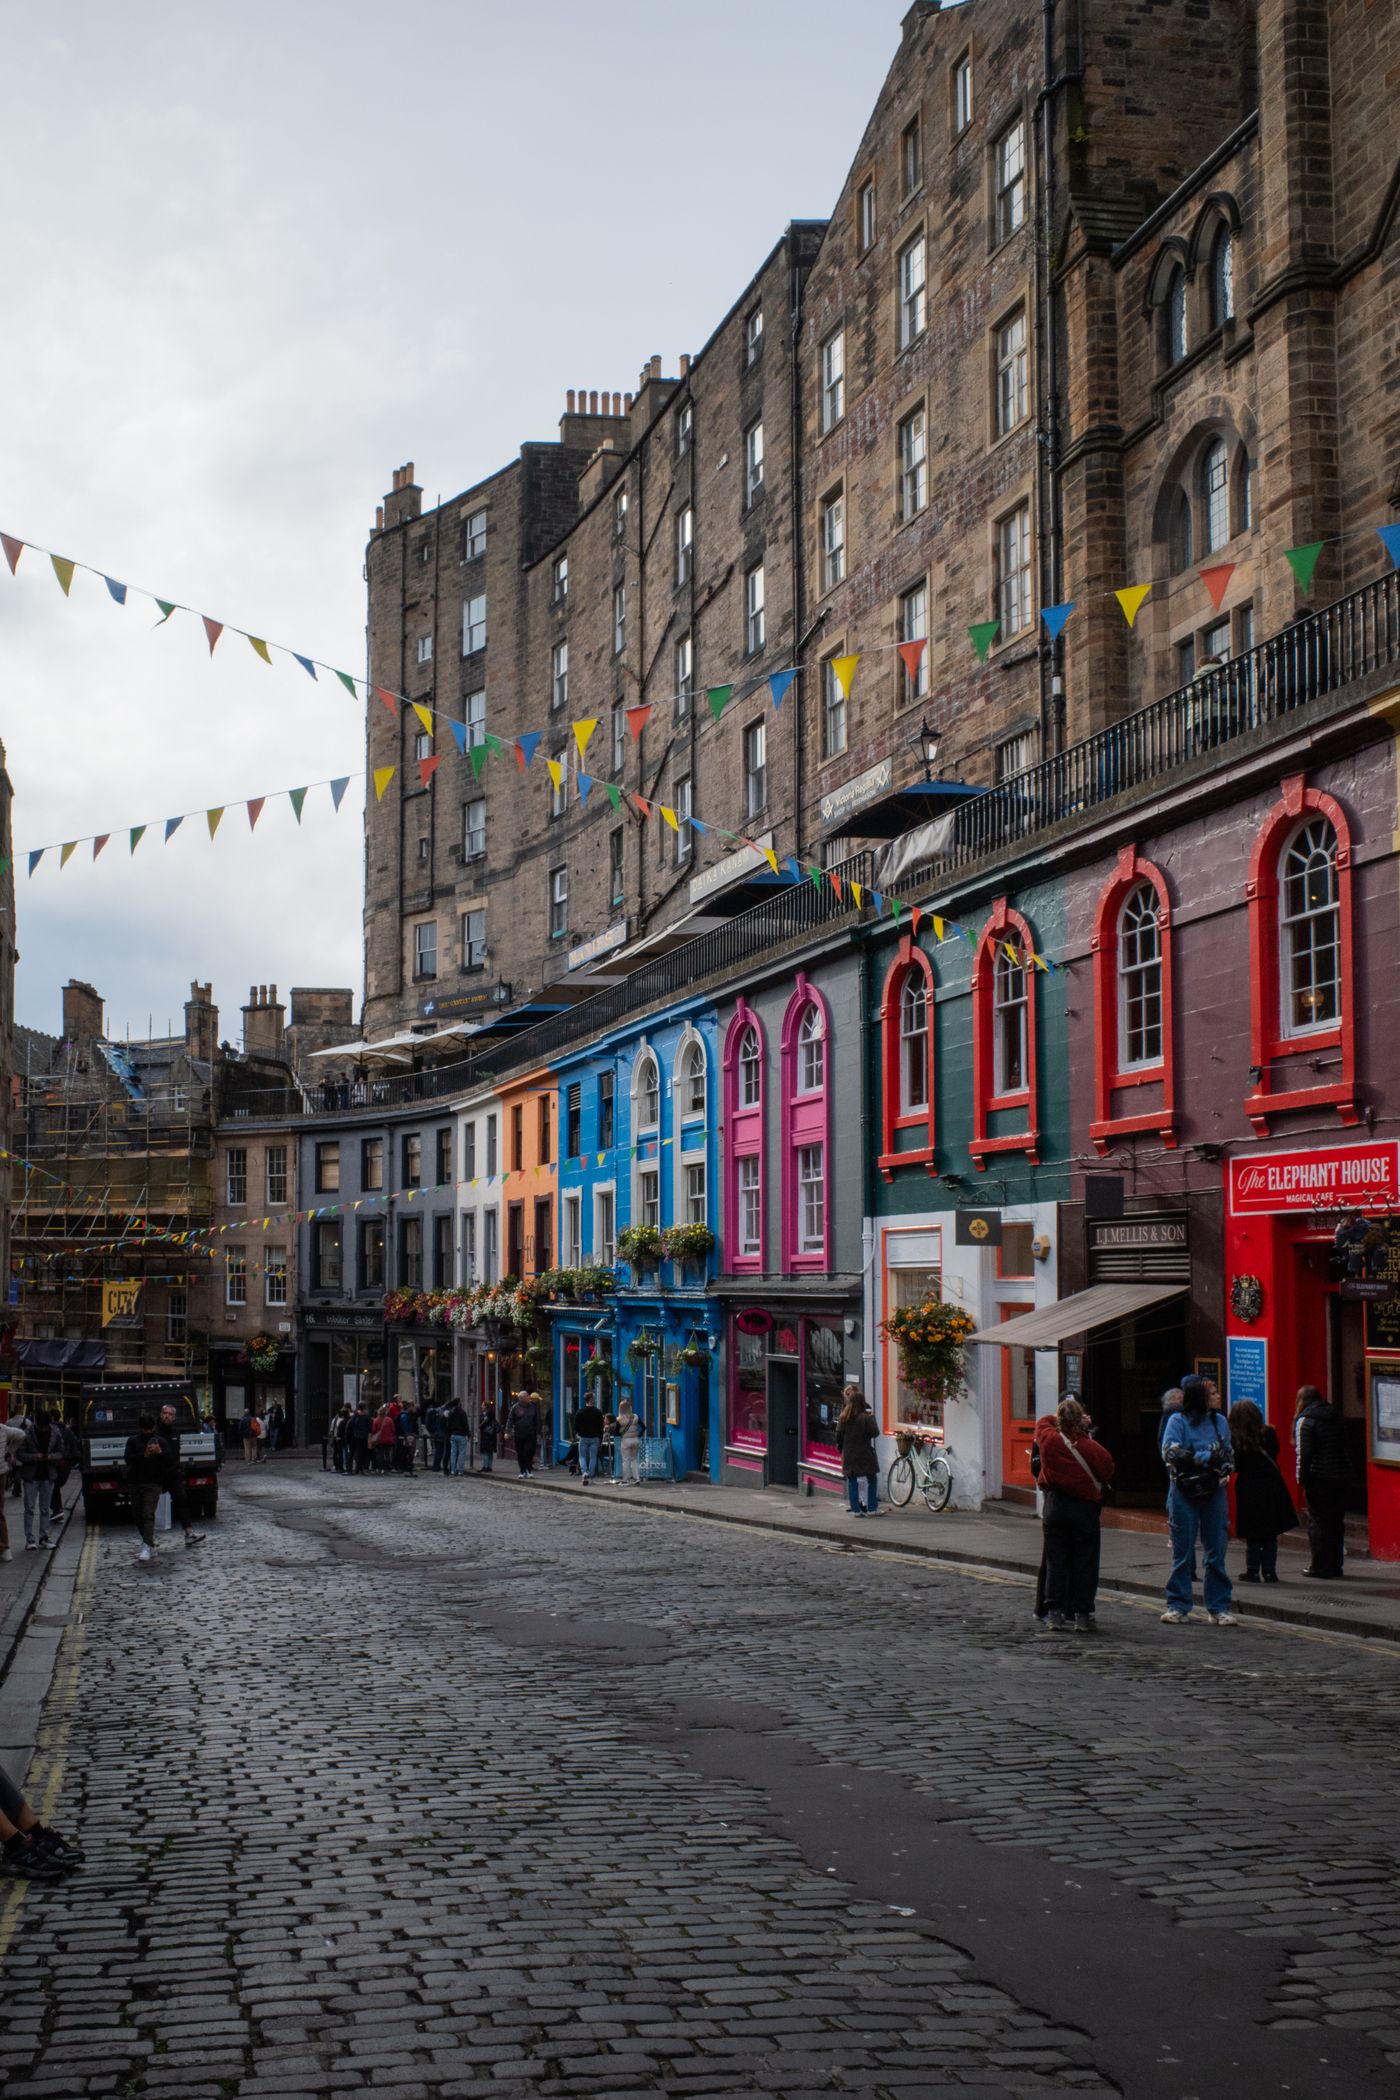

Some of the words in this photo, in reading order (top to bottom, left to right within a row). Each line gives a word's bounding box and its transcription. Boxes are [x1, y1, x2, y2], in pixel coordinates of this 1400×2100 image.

[1237, 1163, 1270, 1196] The
[1267, 1161, 1339, 1191] ELEPHANT
[1341, 1156, 1390, 1186] HOUSE
[1285, 1193, 1314, 1203] MAGICAL
[1150, 1225, 1159, 1241] &
[1161, 1224, 1185, 1241] SON
